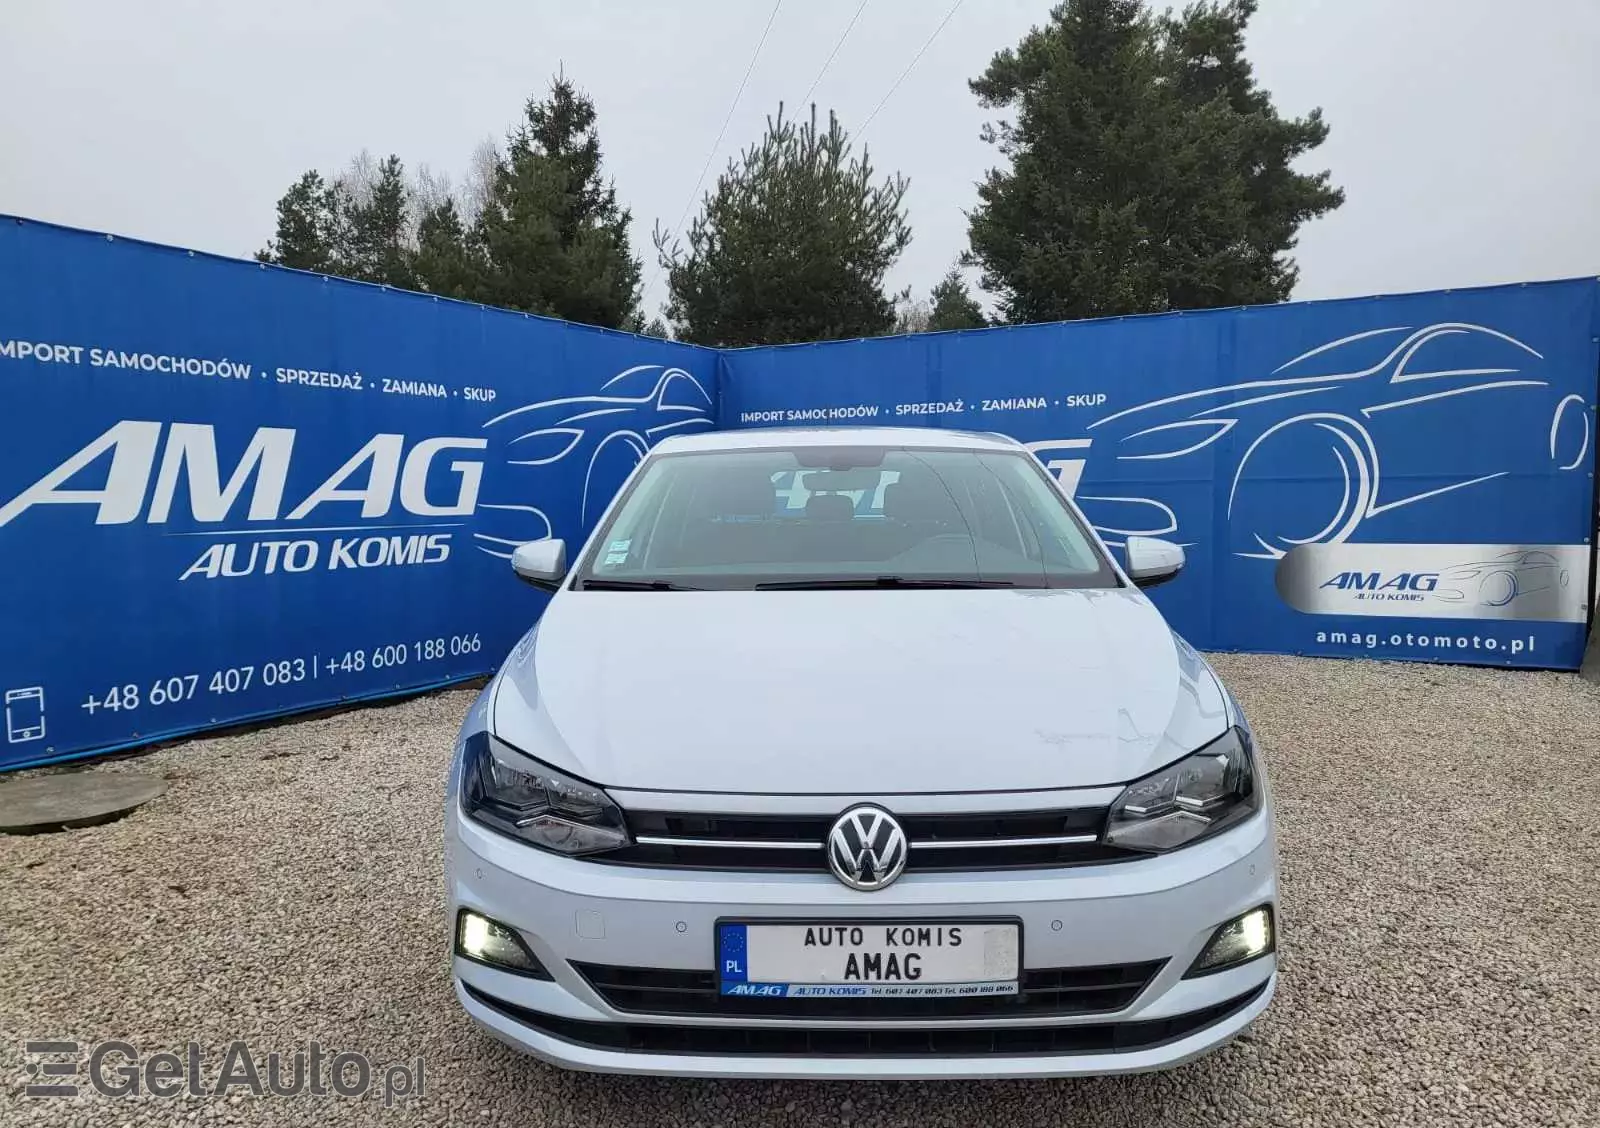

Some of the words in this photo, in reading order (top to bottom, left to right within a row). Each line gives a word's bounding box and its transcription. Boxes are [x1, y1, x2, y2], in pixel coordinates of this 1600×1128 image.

[0, 340, 84, 365] MPORT
[90, 349, 251, 379] SAMOCHODÓW
[276, 367, 363, 390] SPRZEDAŻ
[382, 379, 448, 398] ZAMIANA
[463, 387, 496, 401] SKUP
[741, 410, 785, 422] IMPORT
[786, 405, 879, 420] SAMOCHODÓW
[895, 399, 964, 415] SPRZEDAŻ
[982, 397, 1047, 411] ZAMIANA
[1066, 394, 1107, 407] SKUP
[178, 540, 319, 581] AUTO
[328, 534, 452, 570] KOMIS
[1319, 572, 1440, 591] AMAG
[1316, 631, 1535, 654] amag.otomoto.pl
[81, 684, 140, 715] +48
[150, 674, 199, 705] 607
[208, 666, 254, 694] 407
[263, 657, 305, 686] 083
[325, 650, 366, 675] +48
[372, 644, 407, 668] 600
[414, 638, 445, 662] 188
[450, 633, 481, 655] 066
[804, 927, 864, 947] AUTO
[886, 927, 963, 946] KOMIS
[726, 960, 742, 973] PL
[844, 953, 922, 980] AMAG
[727, 985, 782, 996] AMAG
[794, 987, 826, 996] AUTO
[828, 987, 867, 995] KOMIS
